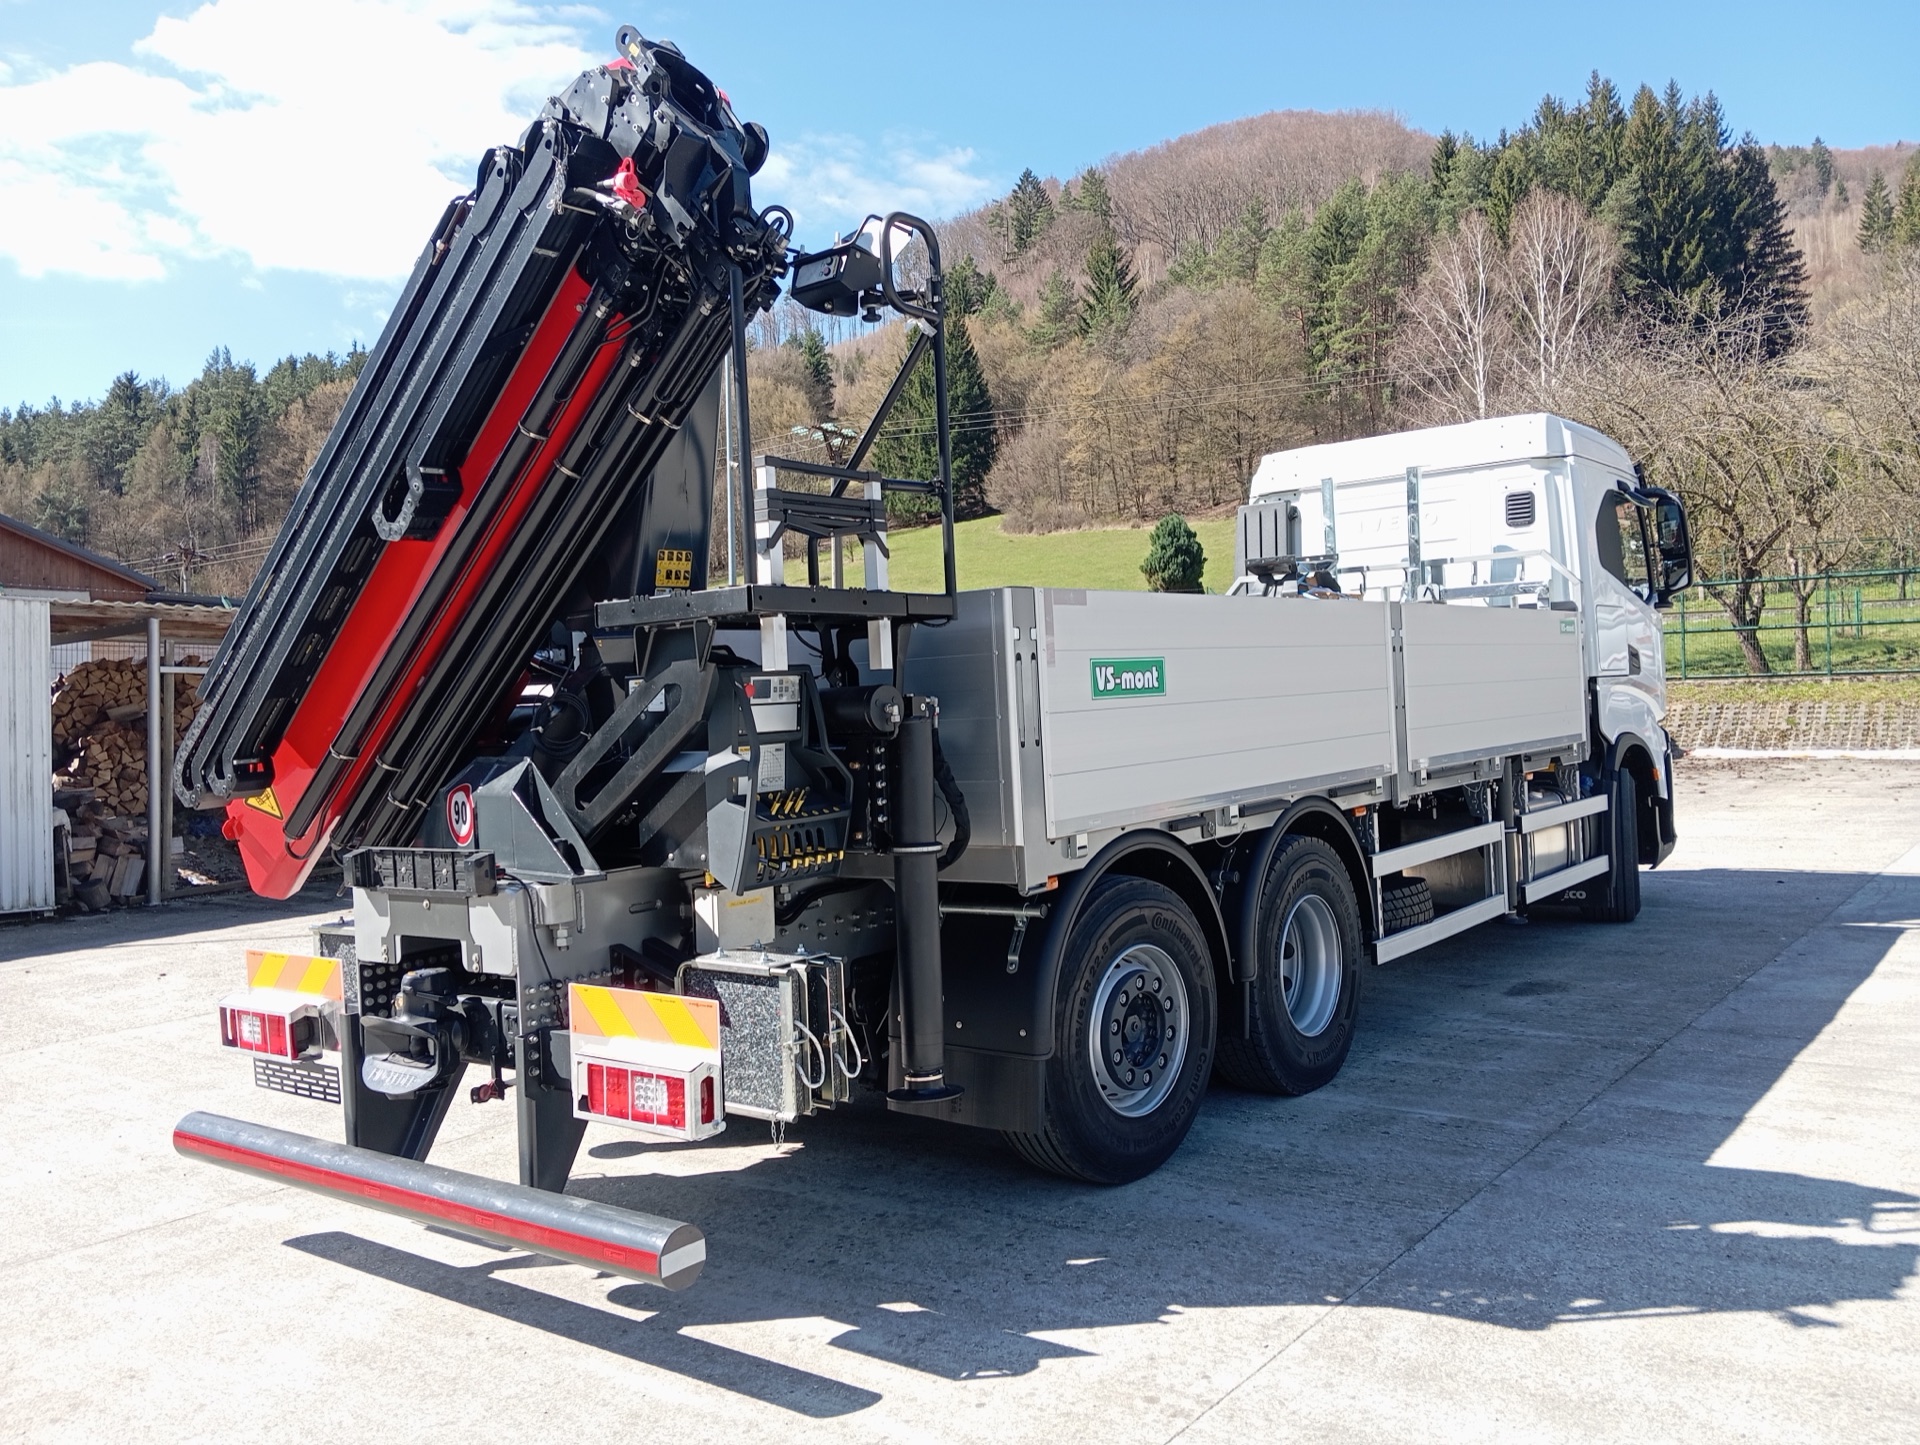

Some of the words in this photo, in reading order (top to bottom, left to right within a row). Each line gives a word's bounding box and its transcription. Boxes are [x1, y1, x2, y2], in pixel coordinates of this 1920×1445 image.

[1094, 666, 1159, 691] VS-mont
[454, 800, 467, 825] 90
[1151, 911, 1202, 968] Continental
[1083, 981, 1092, 993] R
[1089, 941, 1109, 980] 22.5
[1189, 1052, 1208, 1095] Conti
